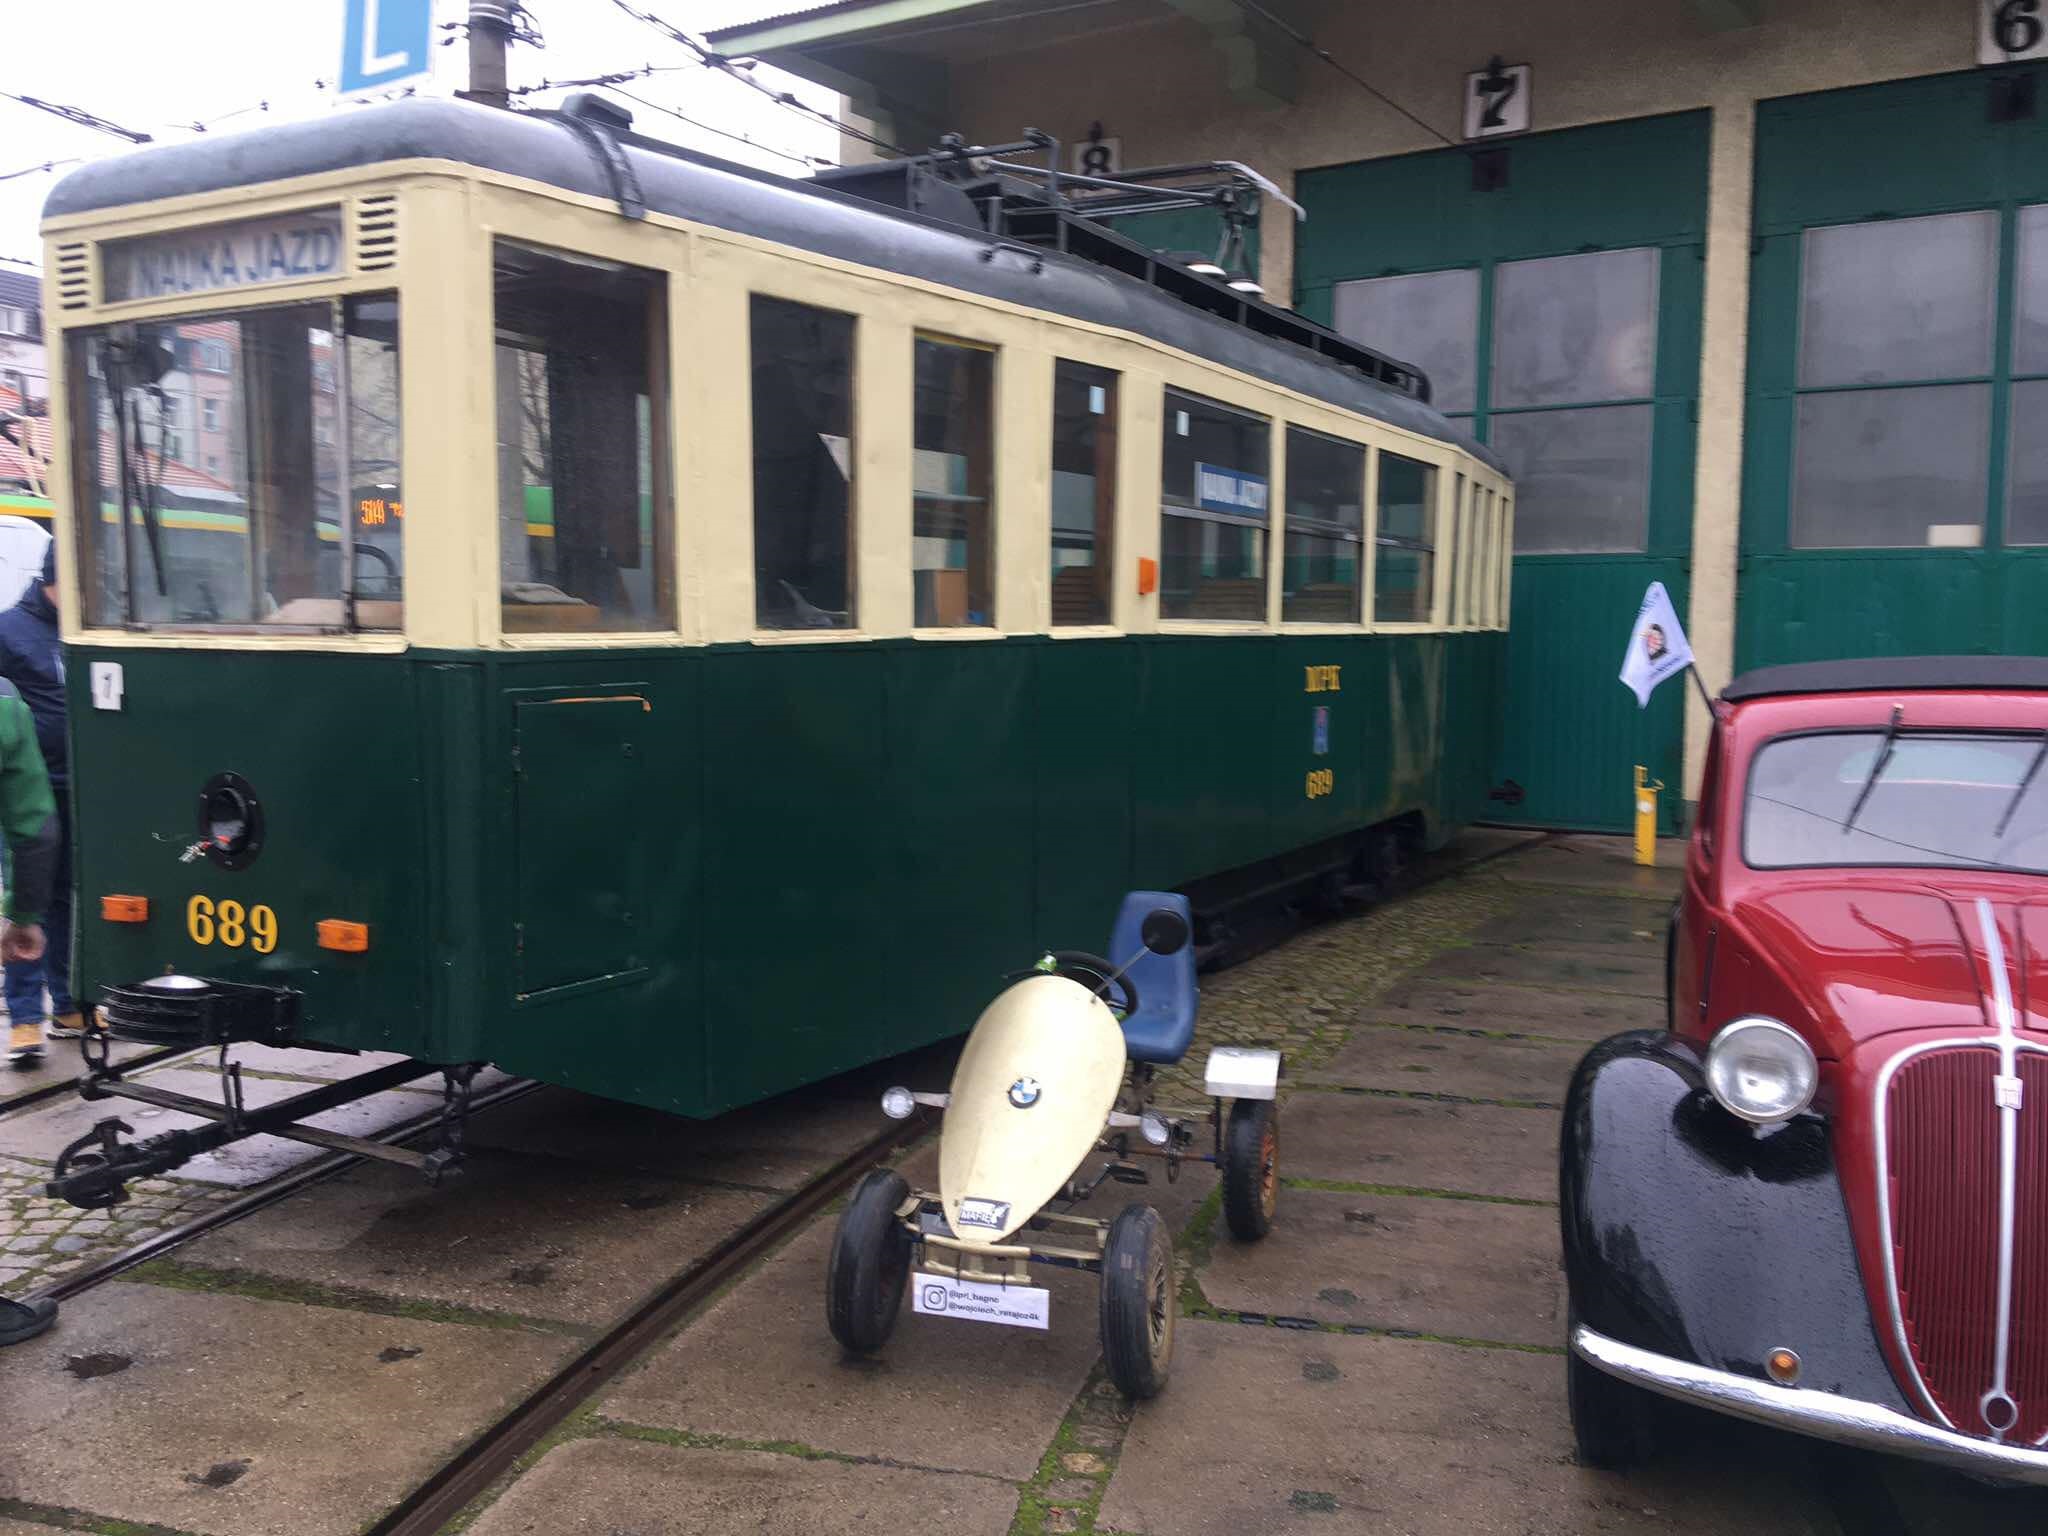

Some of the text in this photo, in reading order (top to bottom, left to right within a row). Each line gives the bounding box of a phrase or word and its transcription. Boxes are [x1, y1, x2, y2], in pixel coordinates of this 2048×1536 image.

[360, 0, 409, 76] L
[1993, 0, 2042, 52] 6
[1477, 75, 1519, 128] 7
[135, 240, 242, 298] NAUKA
[1305, 768, 1333, 800] 689
[187, 894, 279, 954] 689
